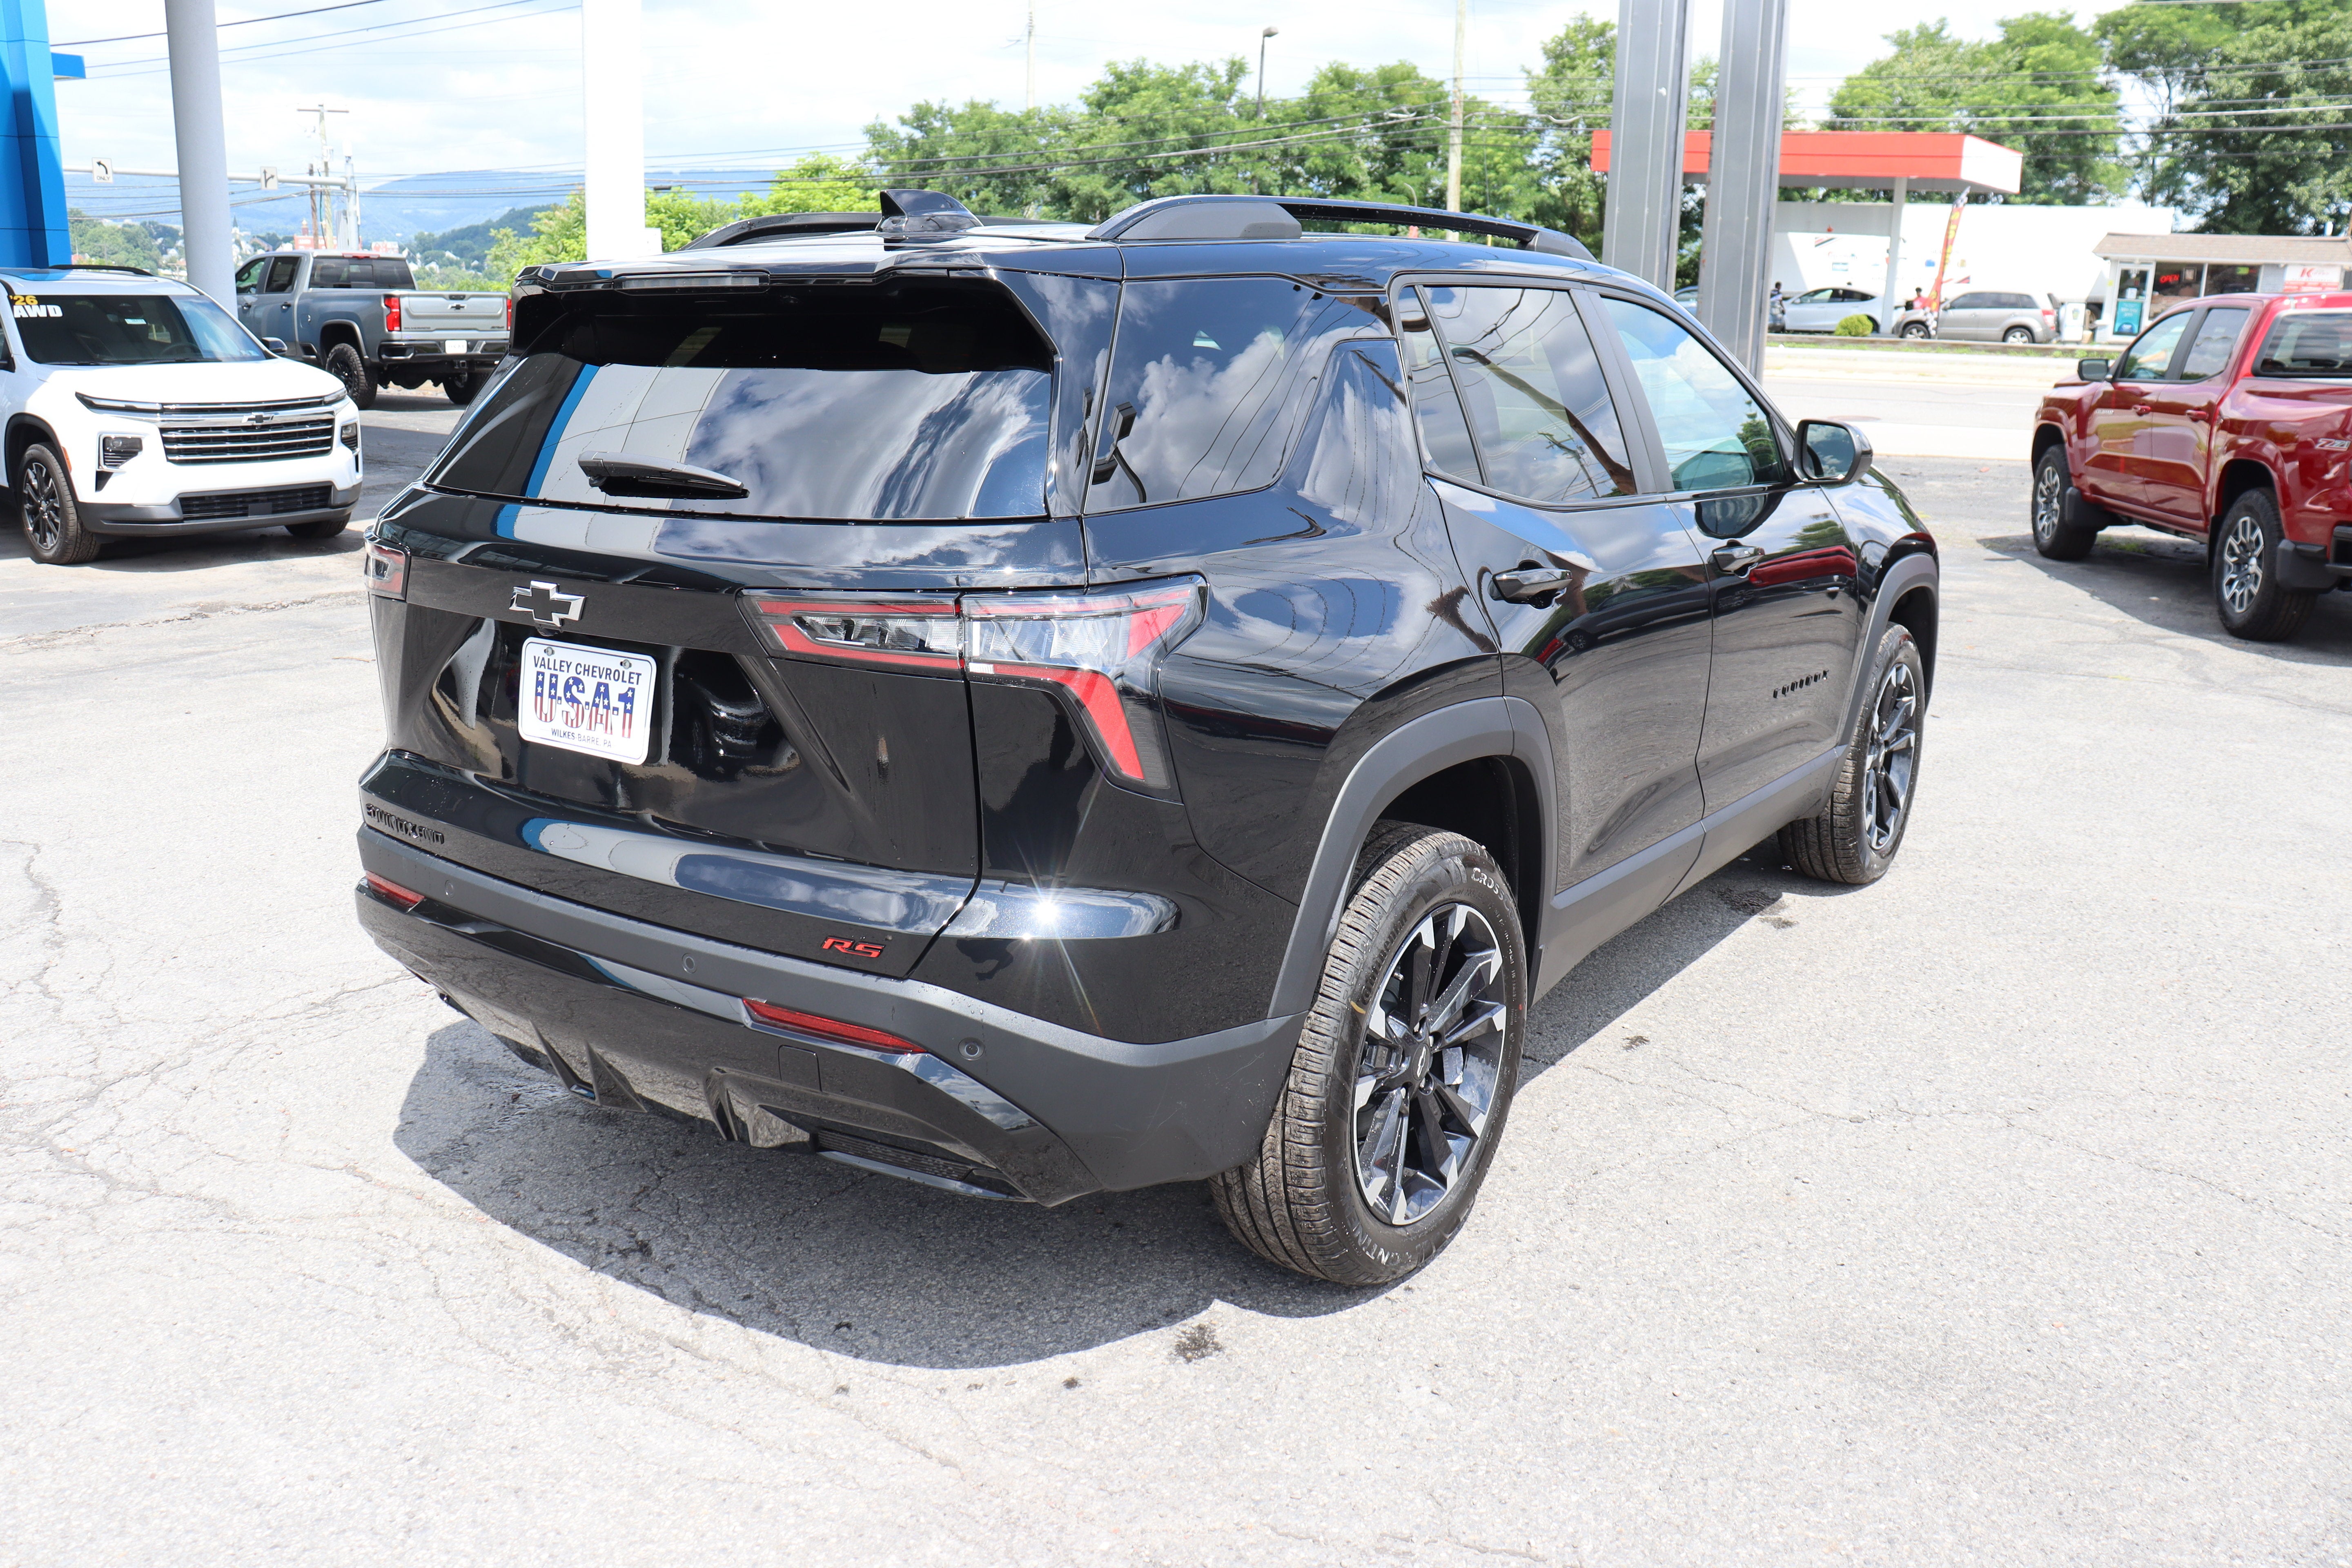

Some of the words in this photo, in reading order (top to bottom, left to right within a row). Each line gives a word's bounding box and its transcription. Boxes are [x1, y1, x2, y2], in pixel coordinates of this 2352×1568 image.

[2159, 274, 2180, 284] OPEN
[13, 305, 63, 318] AWD
[534, 655, 572, 673] VALLEY
[575, 662, 641, 685] CHEVROLET
[603, 739, 612, 748] PA
[820, 935, 886, 958] RS
